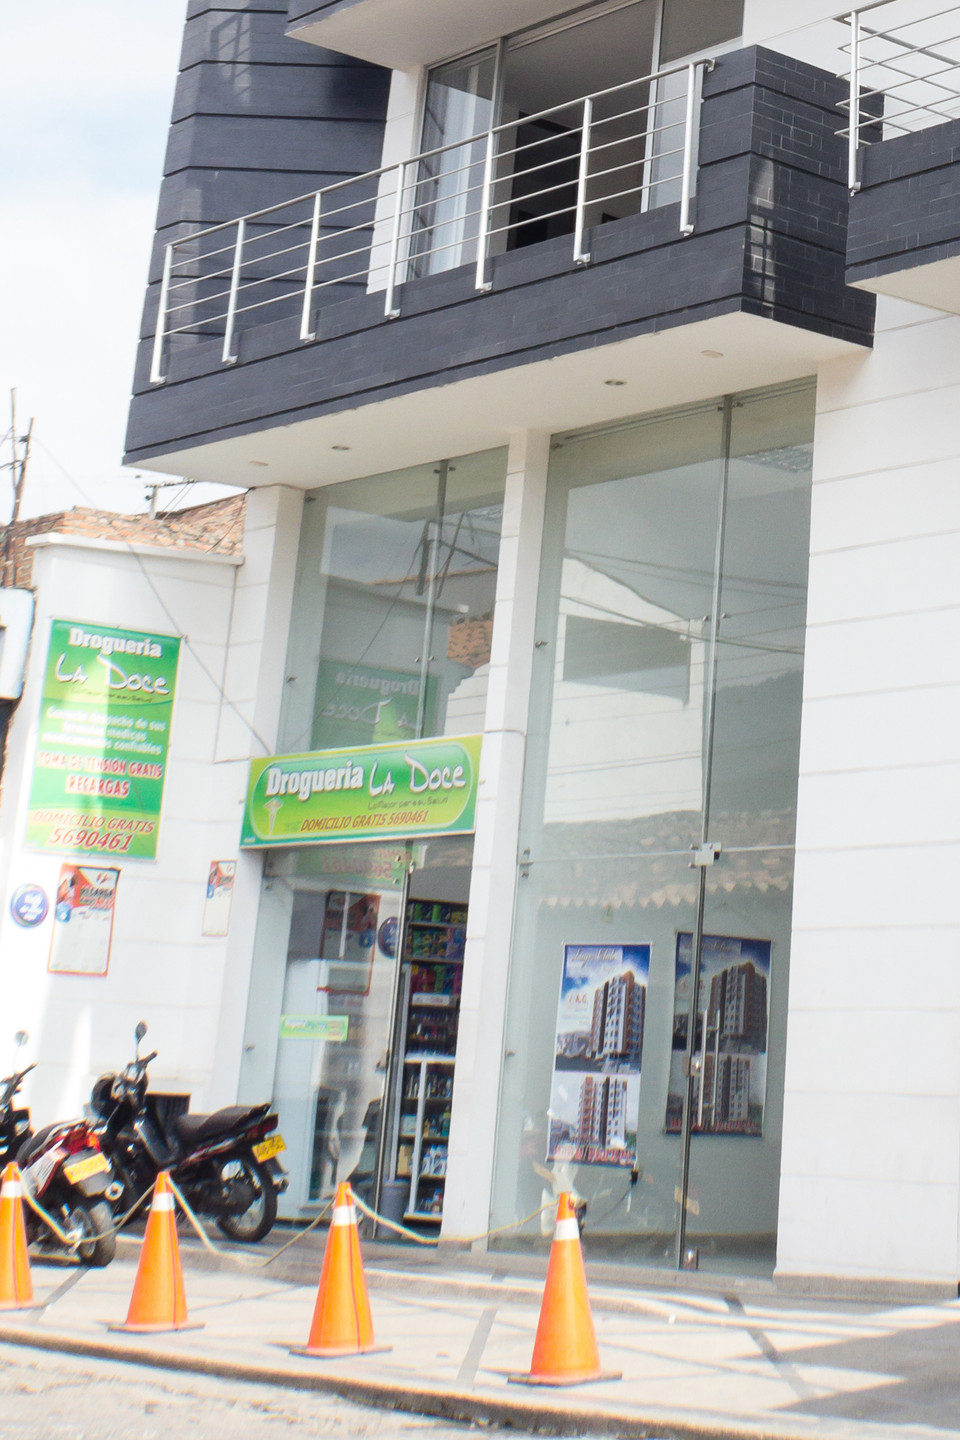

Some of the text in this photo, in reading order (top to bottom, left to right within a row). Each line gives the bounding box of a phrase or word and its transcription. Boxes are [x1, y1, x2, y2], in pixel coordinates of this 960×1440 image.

[68, 626, 163, 658] Drogueria
[55, 652, 170, 695] LA Doce
[68, 754, 83, 770] DE
[128, 761, 164, 779] GRATIS
[265, 751, 466, 801] Drogueria LA Doce
[66, 775, 130, 798] RECARGAS
[32, 811, 157, 834] DOMICILIO GRATIS
[300, 809, 429, 832] DOMICILIO GRATIS 5690461
[46, 827, 134, 853] 5690461
